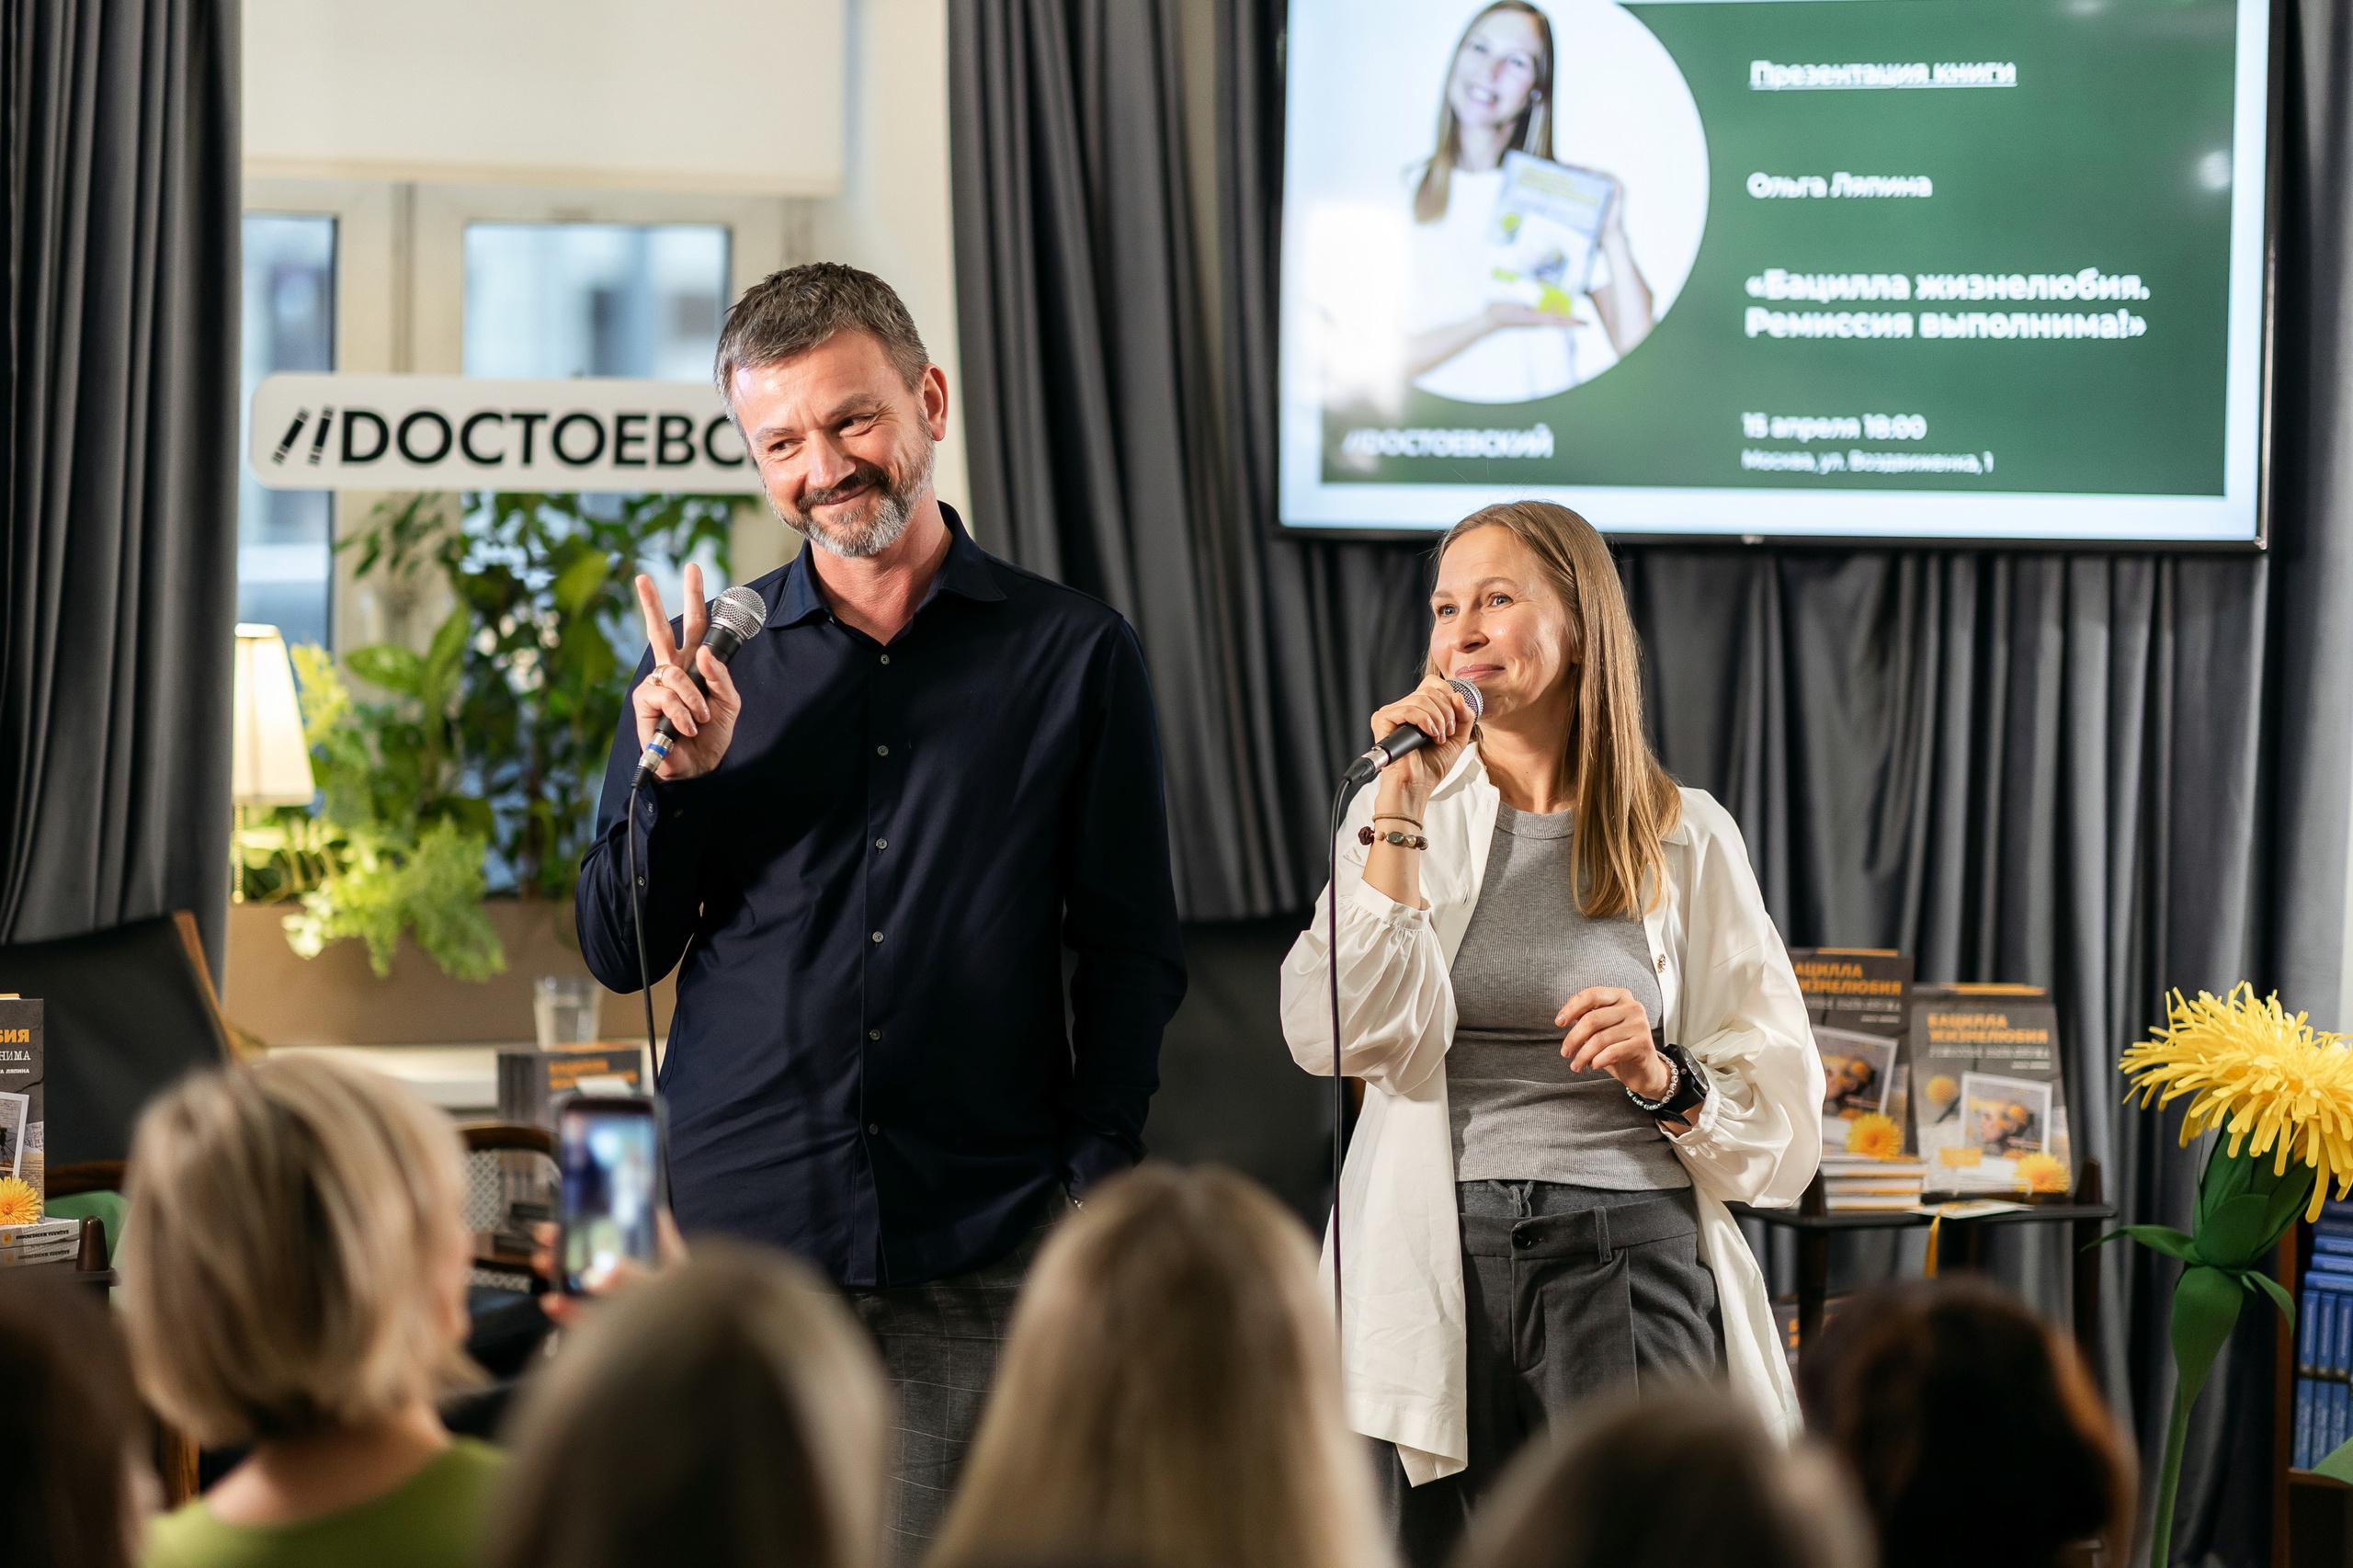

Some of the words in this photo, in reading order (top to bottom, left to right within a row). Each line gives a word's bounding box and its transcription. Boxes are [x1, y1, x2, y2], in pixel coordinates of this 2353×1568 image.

[1749, 60, 1929, 90] Презентация
[1932, 62, 2017, 87] книги
[1746, 172, 1827, 199] Ольга
[1829, 172, 1933, 198] Ляпина
[1745, 268, 1911, 303] «Бацилла
[1915, 267, 2150, 301] жизнелюбия.
[1745, 306, 1914, 338] Ремиссия
[1918, 308, 2147, 339] выполнима!»
[1769, 416, 1861, 443] апреля
[1862, 413, 1927, 440] 18:00
[1793, 961, 1863, 979] АЦИЛЛА
